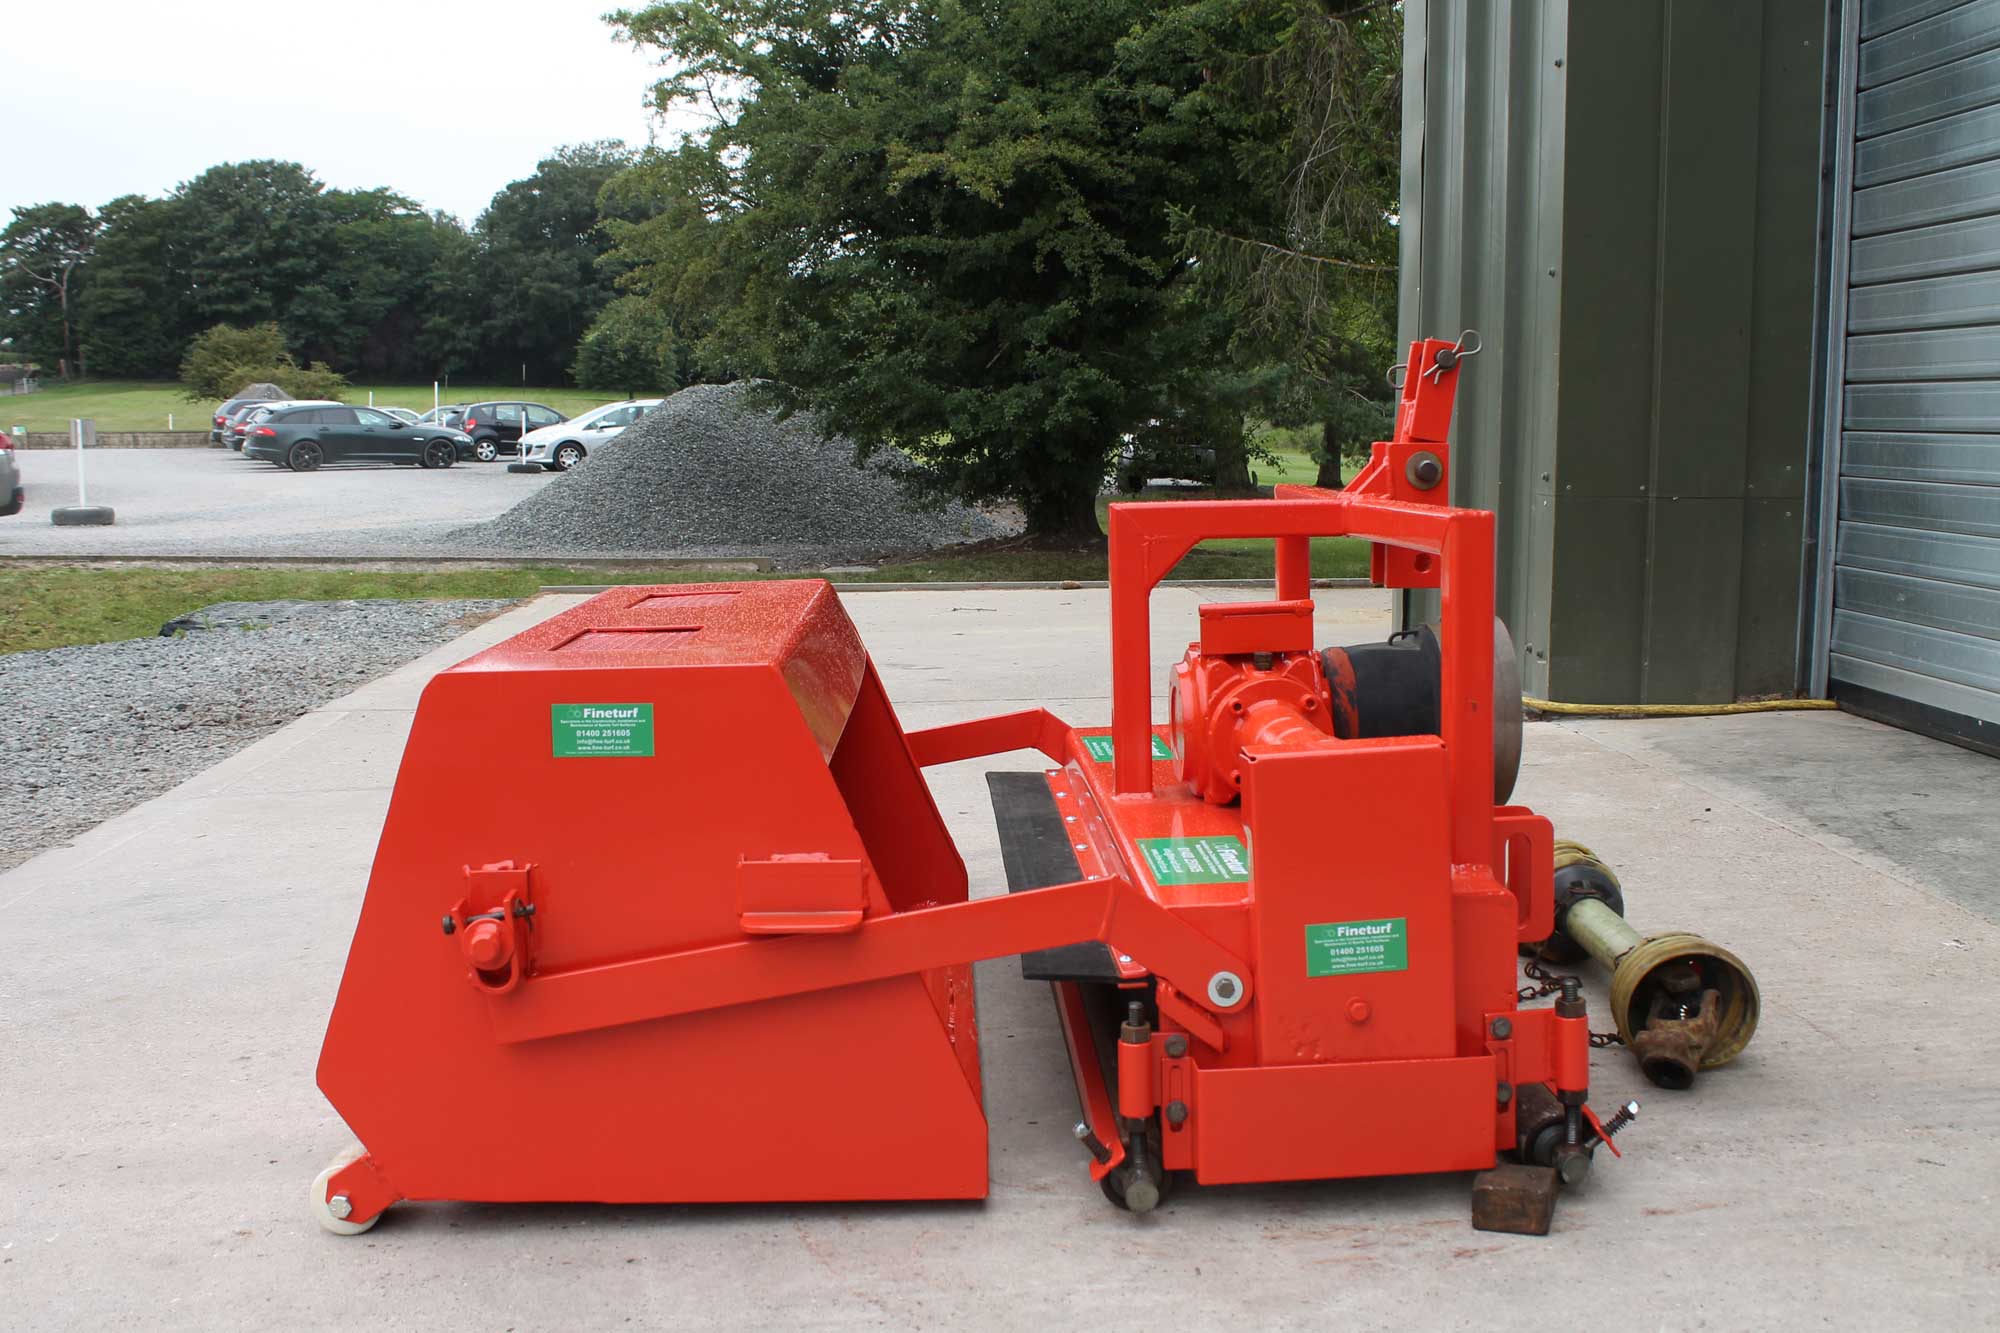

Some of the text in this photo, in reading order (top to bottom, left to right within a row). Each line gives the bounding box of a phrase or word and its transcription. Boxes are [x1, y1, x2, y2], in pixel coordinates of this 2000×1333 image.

[583, 707, 639, 719] Fineturf
[576, 729, 631, 738] 01400 251605
[1337, 922, 1393, 938] Fineturf
[1330, 947, 1354, 956] 01400
